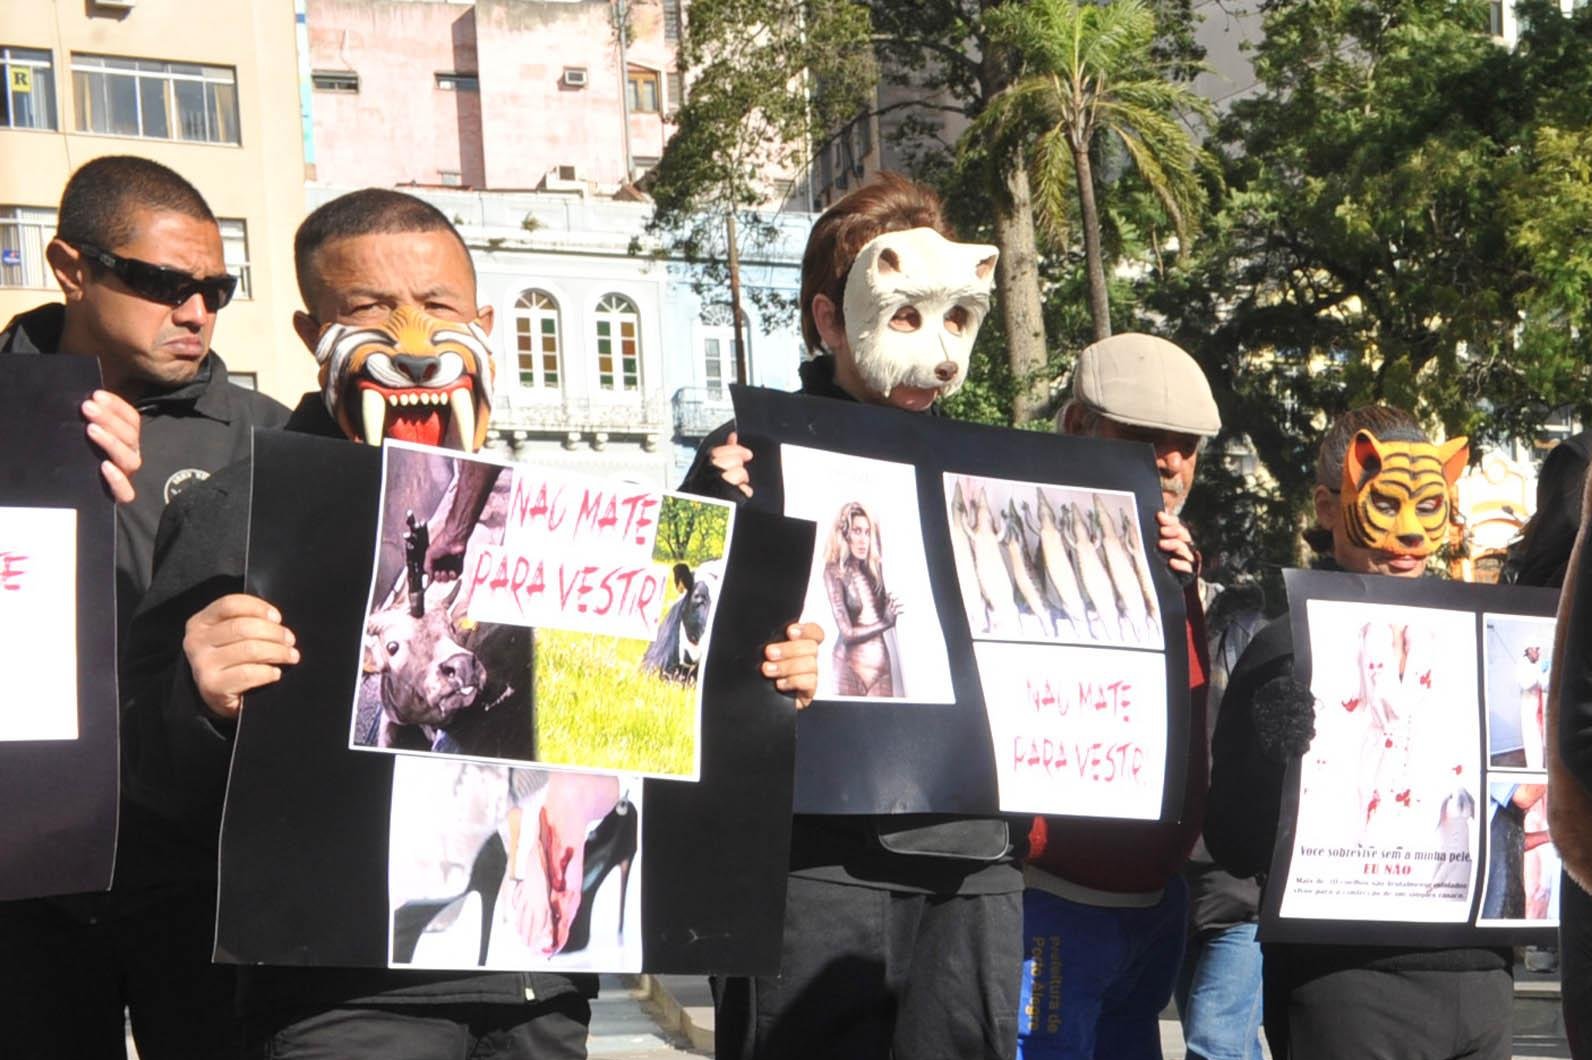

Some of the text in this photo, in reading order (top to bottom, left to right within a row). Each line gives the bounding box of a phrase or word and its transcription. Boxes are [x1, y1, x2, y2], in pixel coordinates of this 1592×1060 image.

[14, 71, 28, 86] R
[573, 488, 657, 545] MATE
[468, 550, 545, 618] PARA
[1381, 849, 1402, 860] sem
[1404, 851, 1411, 861] a
[1414, 850, 1447, 862] minha
